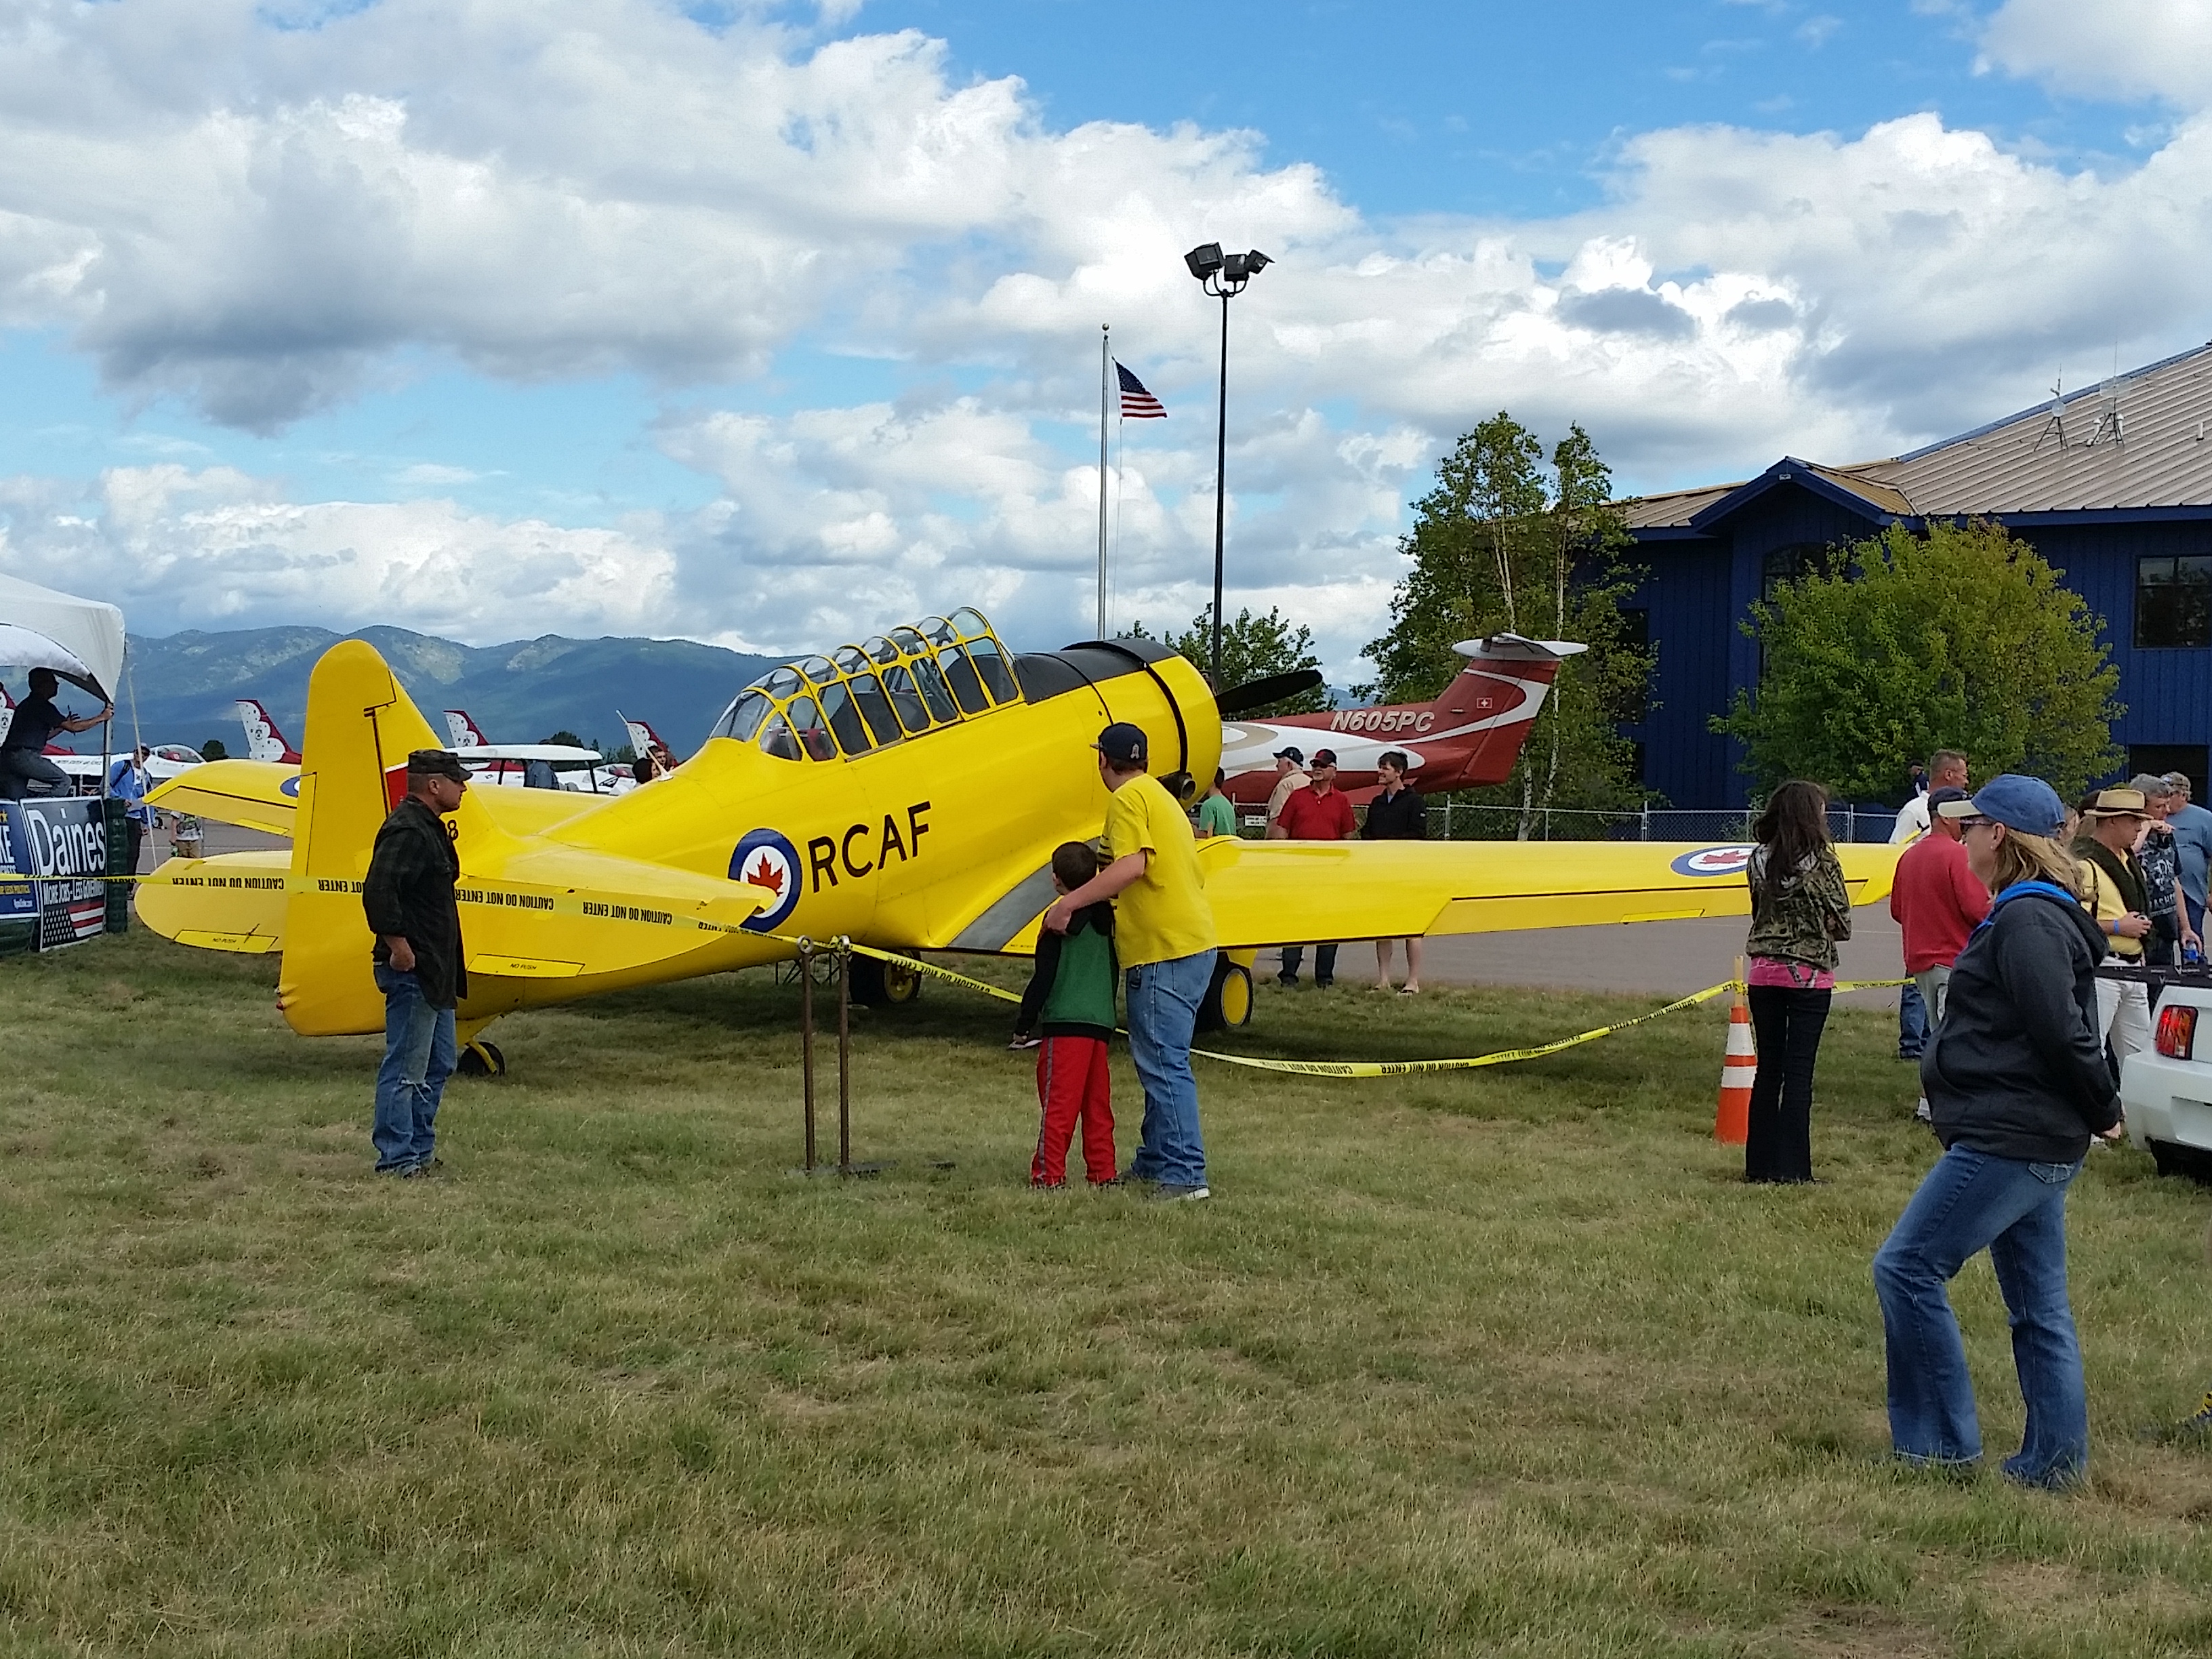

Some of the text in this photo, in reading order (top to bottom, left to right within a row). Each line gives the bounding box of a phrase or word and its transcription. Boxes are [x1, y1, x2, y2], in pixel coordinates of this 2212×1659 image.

[1330, 711, 1435, 732] N605PC
[26, 807, 106, 875] Daines
[807, 800, 931, 893] RCAF
[207, 877, 227, 887] NOT
[229, 877, 243, 888] DO
[245, 877, 285, 890] CAUTION
[318, 879, 348, 893] ENTER
[43, 882, 59, 905] MORE
[455, 888, 554, 910] CAUTION DO NOT ENTER
[583, 901, 673, 925] CAUTION DO NOT ENTER
[1317, 1064, 1353, 1074] CAUTION
[1380, 1063, 1406, 1073] ENTER
